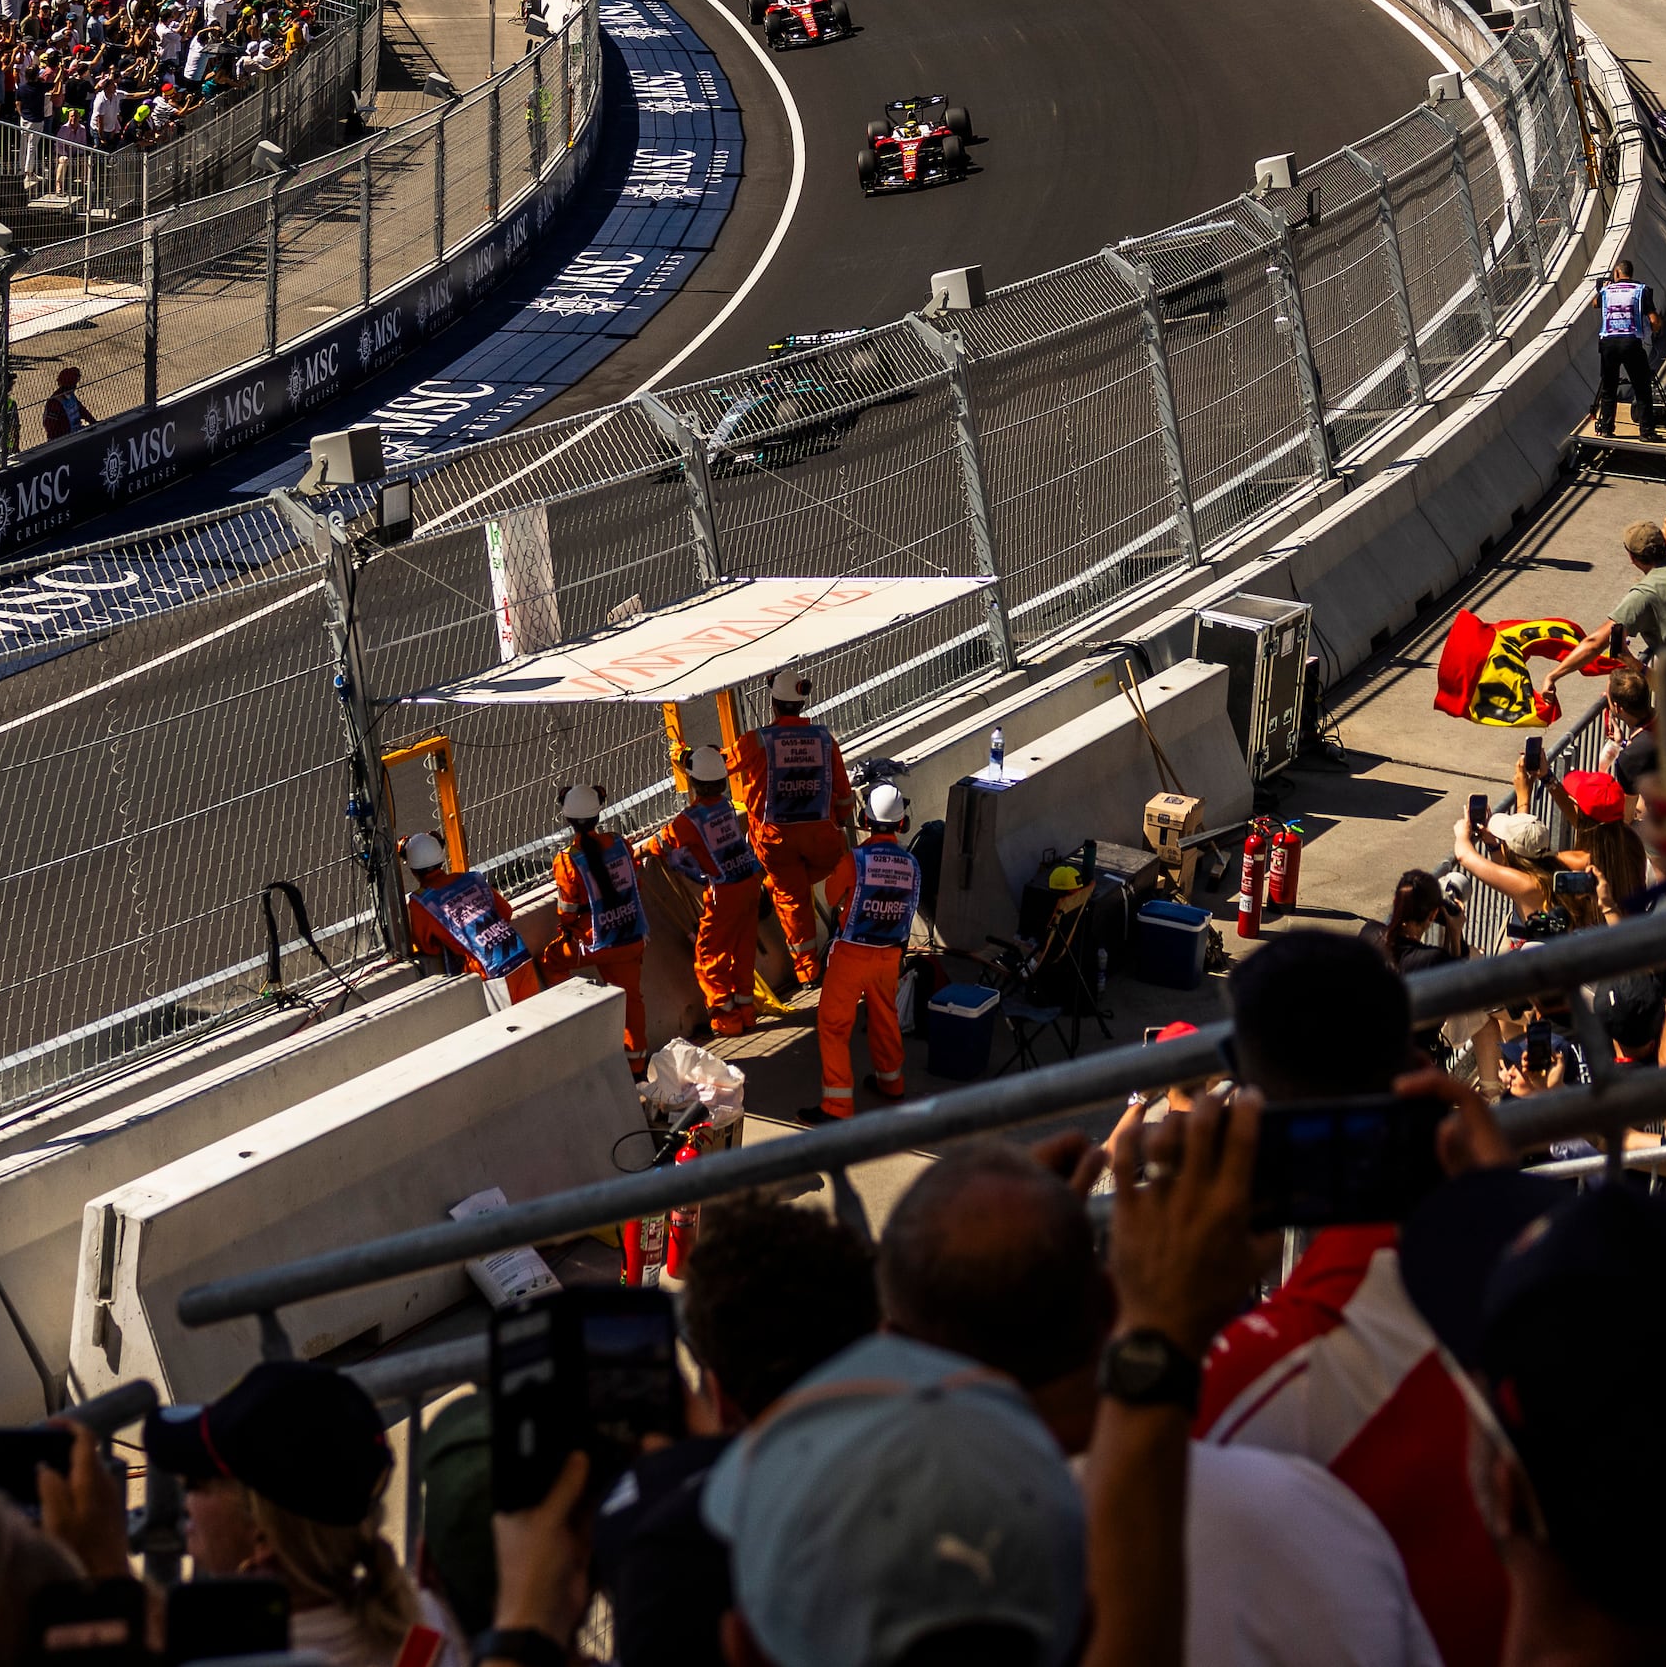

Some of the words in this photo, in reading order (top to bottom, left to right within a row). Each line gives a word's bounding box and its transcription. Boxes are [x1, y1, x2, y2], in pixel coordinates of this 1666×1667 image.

[630, 70, 687, 100] MSC
[629, 148, 697, 183] MSC
[704, 149, 729, 184] CRUISES
[512, 212, 530, 249] MSC
[474, 255, 496, 288] MSC
[546, 251, 644, 294] MSC
[634, 253, 685, 297] CRUISES
[429, 273, 454, 313] MSC
[374, 308, 402, 352] MSC
[305, 342, 339, 389] MSC
[224, 380, 265, 430] MSC
[305, 382, 340, 409] CRUISES
[354, 380, 496, 436] MSC
[449, 386, 545, 440] CRUISES
[128, 421, 176, 474] MSC
[225, 422, 266, 449] CRUISES
[16, 464, 71, 522] MSC
[128, 465, 177, 494] CRUISES
[16, 510, 71, 542] CRUISES
[777, 779, 821, 792] COURSE
[597, 902, 637, 926] COURSE
[862, 899, 906, 913] COURSE
